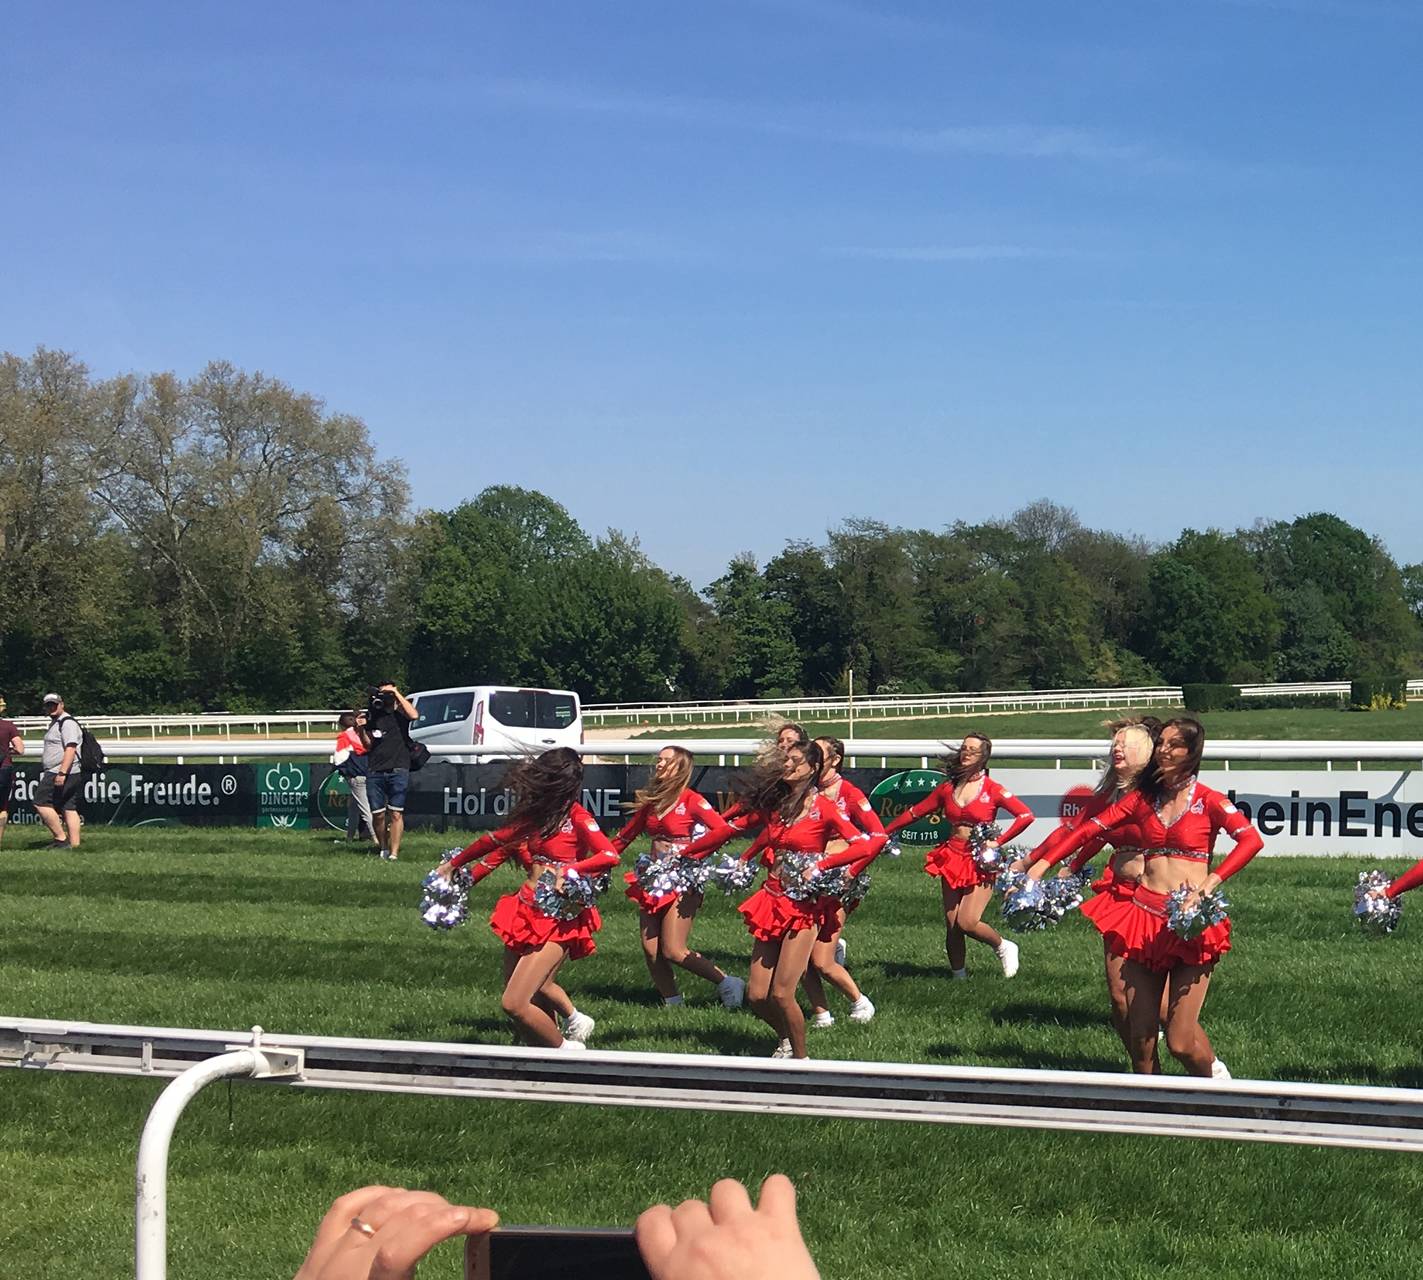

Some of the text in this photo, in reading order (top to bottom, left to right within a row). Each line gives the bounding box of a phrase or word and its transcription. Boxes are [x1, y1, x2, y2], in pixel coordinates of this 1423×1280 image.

[84, 773, 121, 804] die
[443, 787, 486, 816] Hol
[582, 788, 621, 817] NE
[901, 829, 939, 841] SEIT 1718
